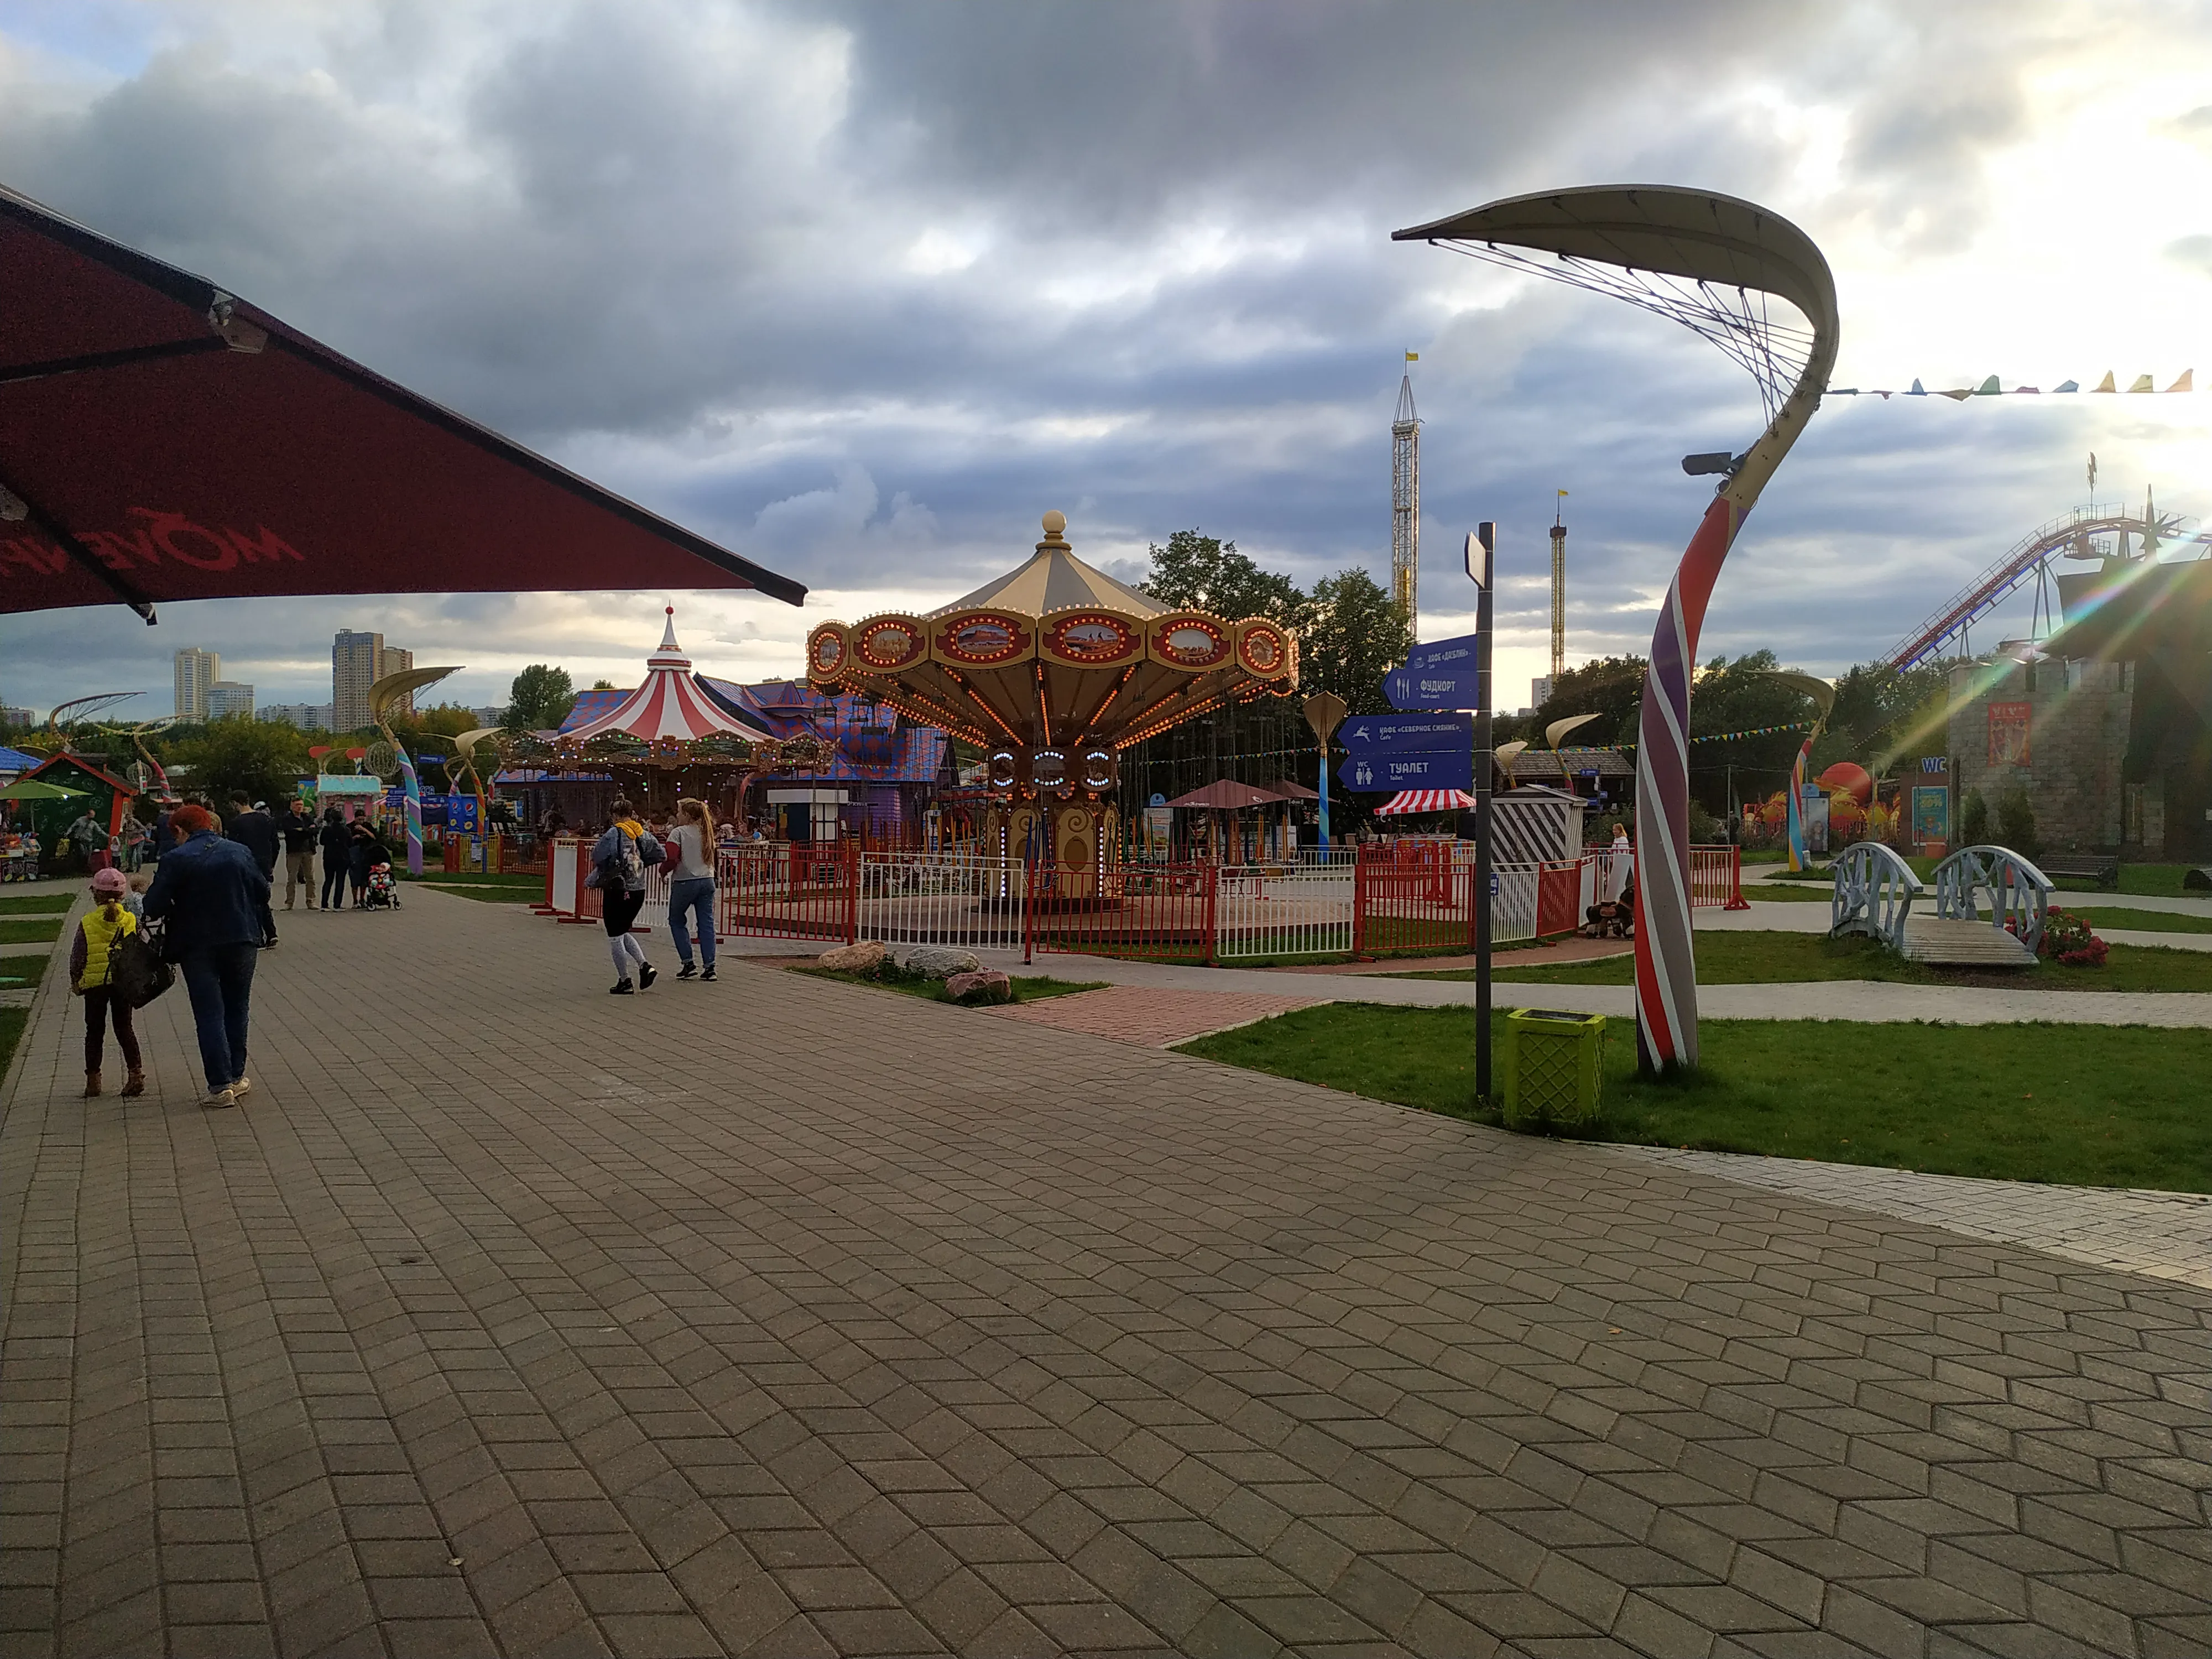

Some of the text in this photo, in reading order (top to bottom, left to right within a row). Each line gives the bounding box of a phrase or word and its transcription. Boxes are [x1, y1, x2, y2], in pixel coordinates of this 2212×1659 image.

[1427, 653, 1441, 663] КАФЕ
[1420, 679, 1456, 692] ФУДКОРТ
[1379, 723, 1459, 734] КАФЕ «СЕВЕРНОЕ СИЯНИЕ»
[1389, 762, 1429, 774] ТУАЛЕТ
[1922, 757, 1947, 774] WC
